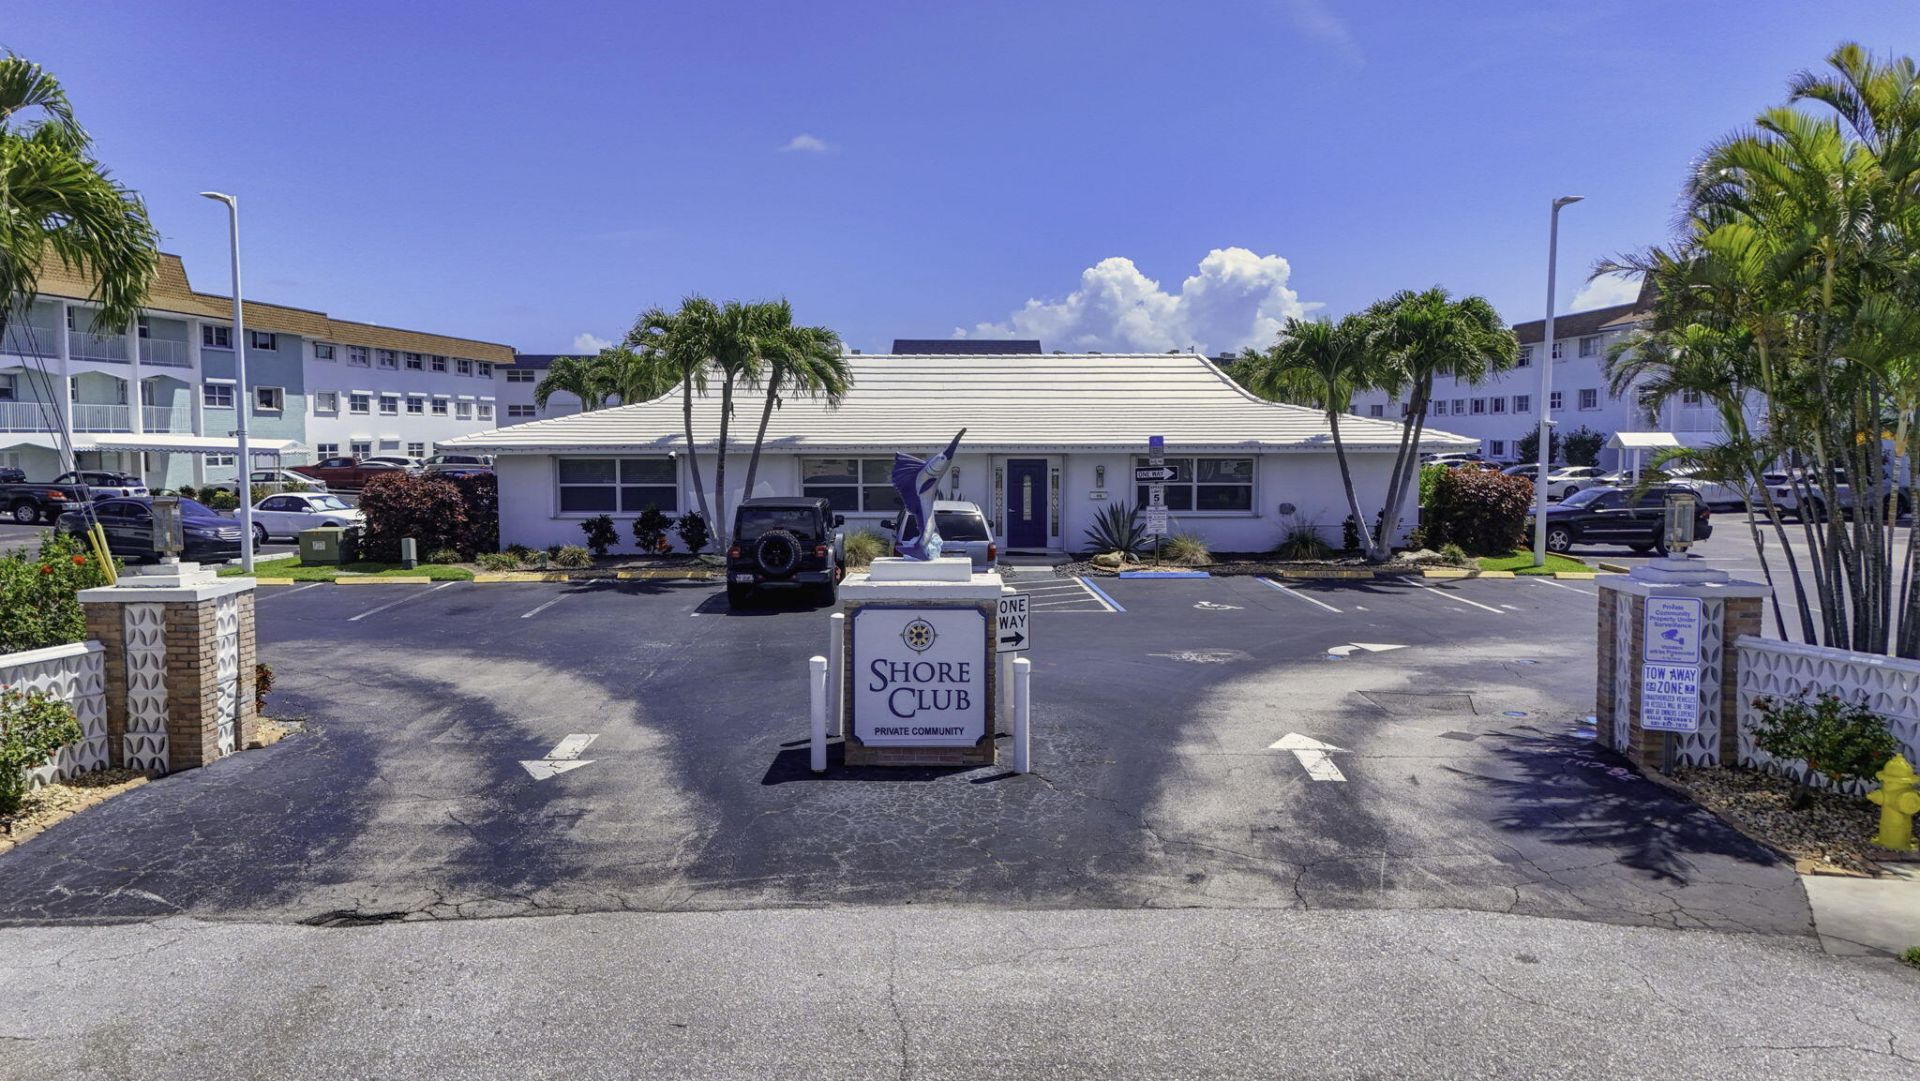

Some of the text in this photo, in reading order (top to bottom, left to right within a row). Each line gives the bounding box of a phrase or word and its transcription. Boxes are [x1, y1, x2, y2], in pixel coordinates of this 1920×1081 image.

[1153, 494, 1160, 502] 5
[1000, 599, 1025, 614] ONE
[999, 614, 1027, 629] WAY
[869, 658, 971, 692] SHORE
[1646, 667, 1696, 681] TOW AWAY
[1657, 681, 1683, 695] ZONE
[888, 687, 971, 718] CLUB
[1644, 694, 1675, 702] UNAUTHORIZED
[1678, 710, 1695, 718] EXPENSE
[874, 727, 909, 736] PRIVATE
[911, 727, 965, 736] COMMUNITY
